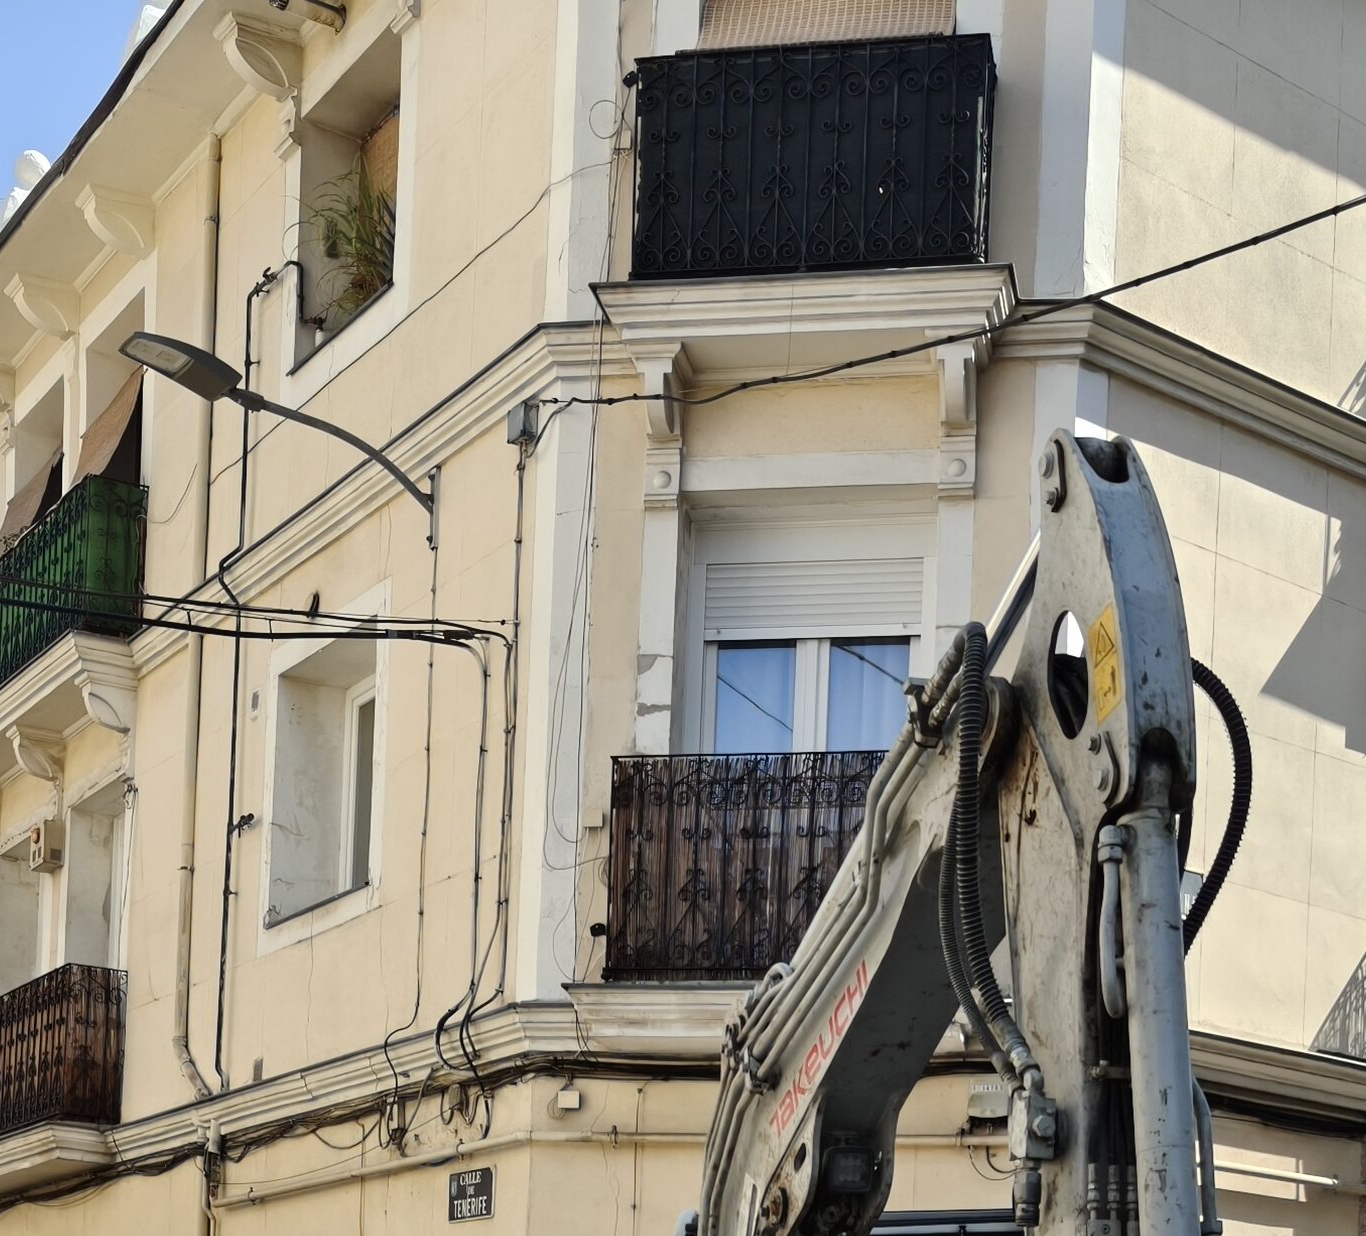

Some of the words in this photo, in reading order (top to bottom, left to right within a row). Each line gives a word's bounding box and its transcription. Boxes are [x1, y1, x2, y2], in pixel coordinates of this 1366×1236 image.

[459, 1171, 482, 1185] CALLE
[466, 1186, 475, 1195] DE
[454, 1196, 487, 1218] TENERIFE
